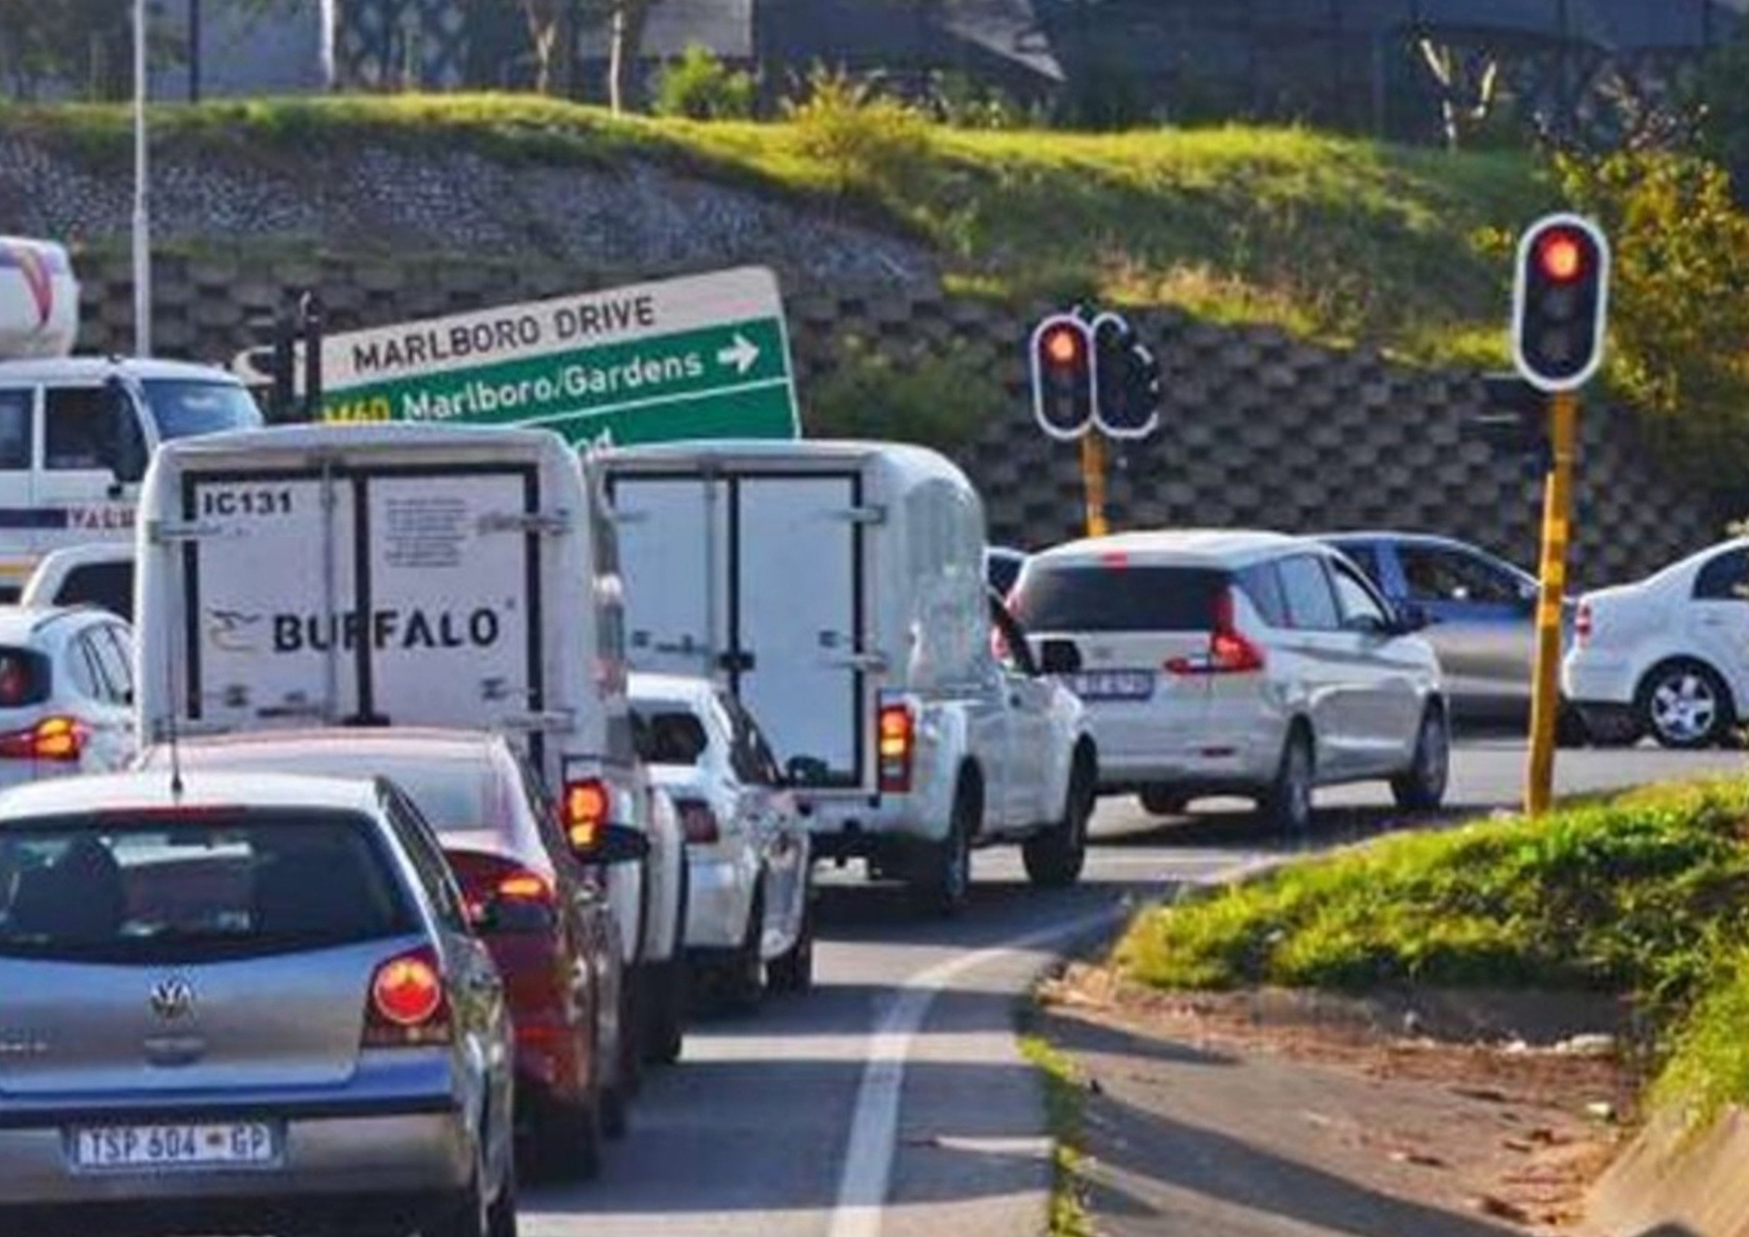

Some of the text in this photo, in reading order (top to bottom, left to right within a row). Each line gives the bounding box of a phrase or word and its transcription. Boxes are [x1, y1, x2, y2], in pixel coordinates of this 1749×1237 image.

[353, 296, 654, 375] MARLBORO DRIVE
[402, 349, 705, 421] Marlboro/Gardens
[71, 507, 136, 530] VALU
[203, 491, 292, 515] IC131
[273, 607, 500, 653] BUFFALO
[91, 1124, 264, 1160] TSP 604 GP
